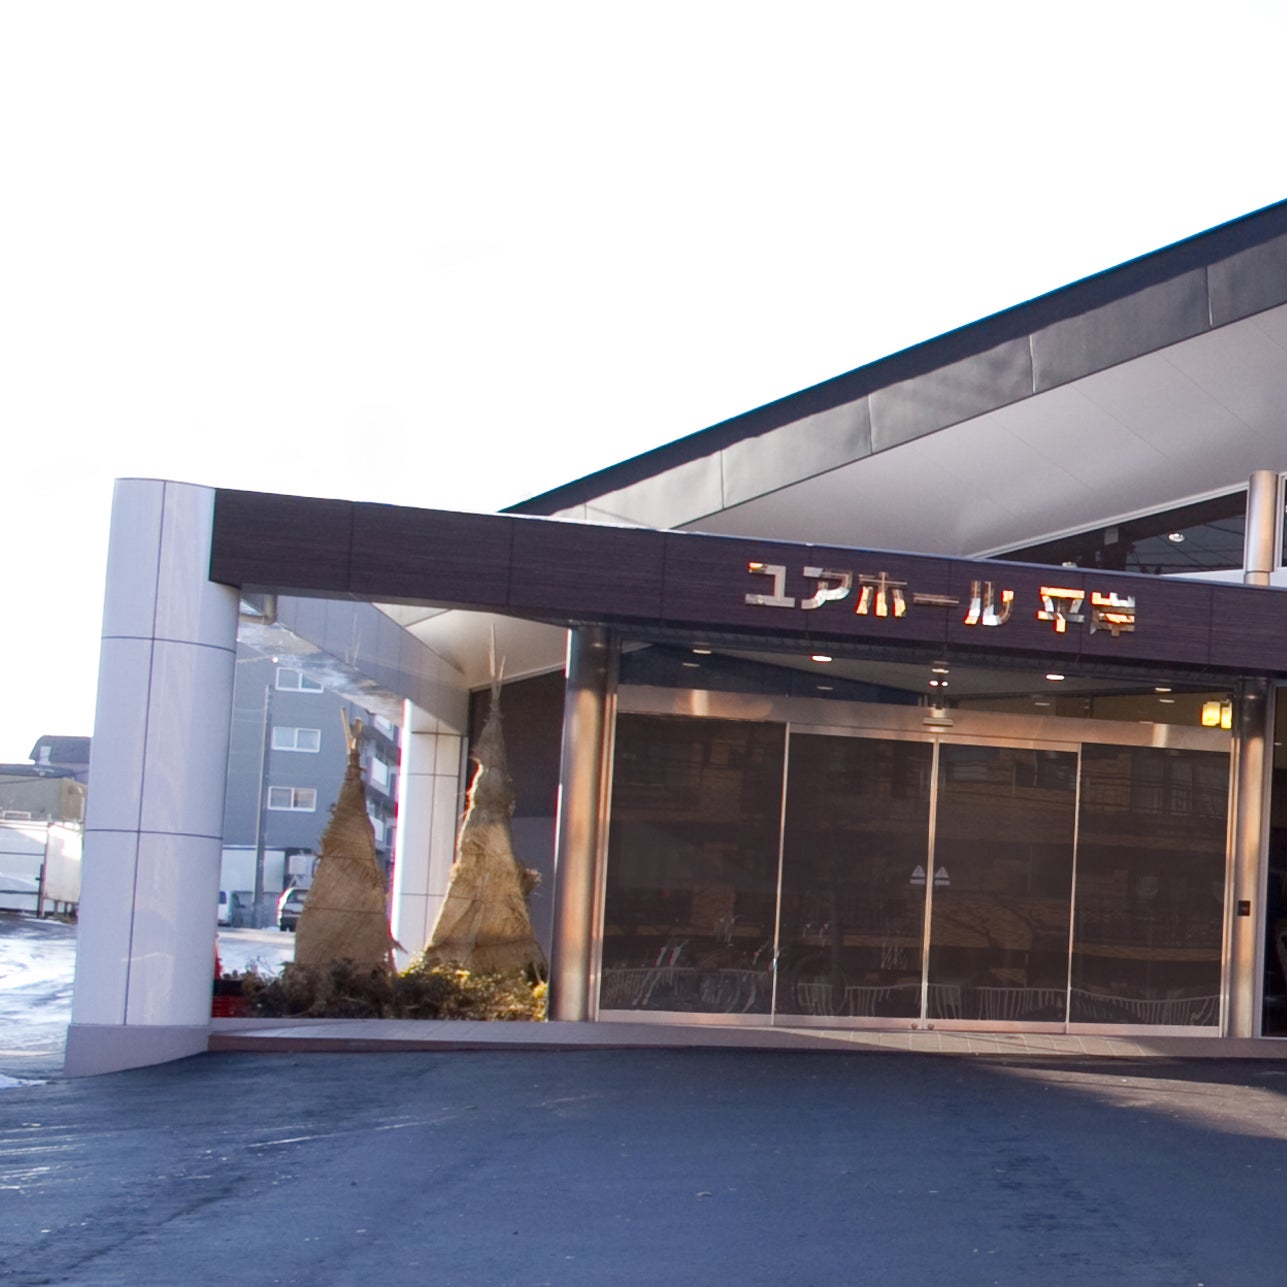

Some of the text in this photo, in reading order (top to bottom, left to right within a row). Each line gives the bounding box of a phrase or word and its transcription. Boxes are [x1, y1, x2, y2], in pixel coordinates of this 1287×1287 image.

[745, 562, 1136, 637] ユアホール 平岸
